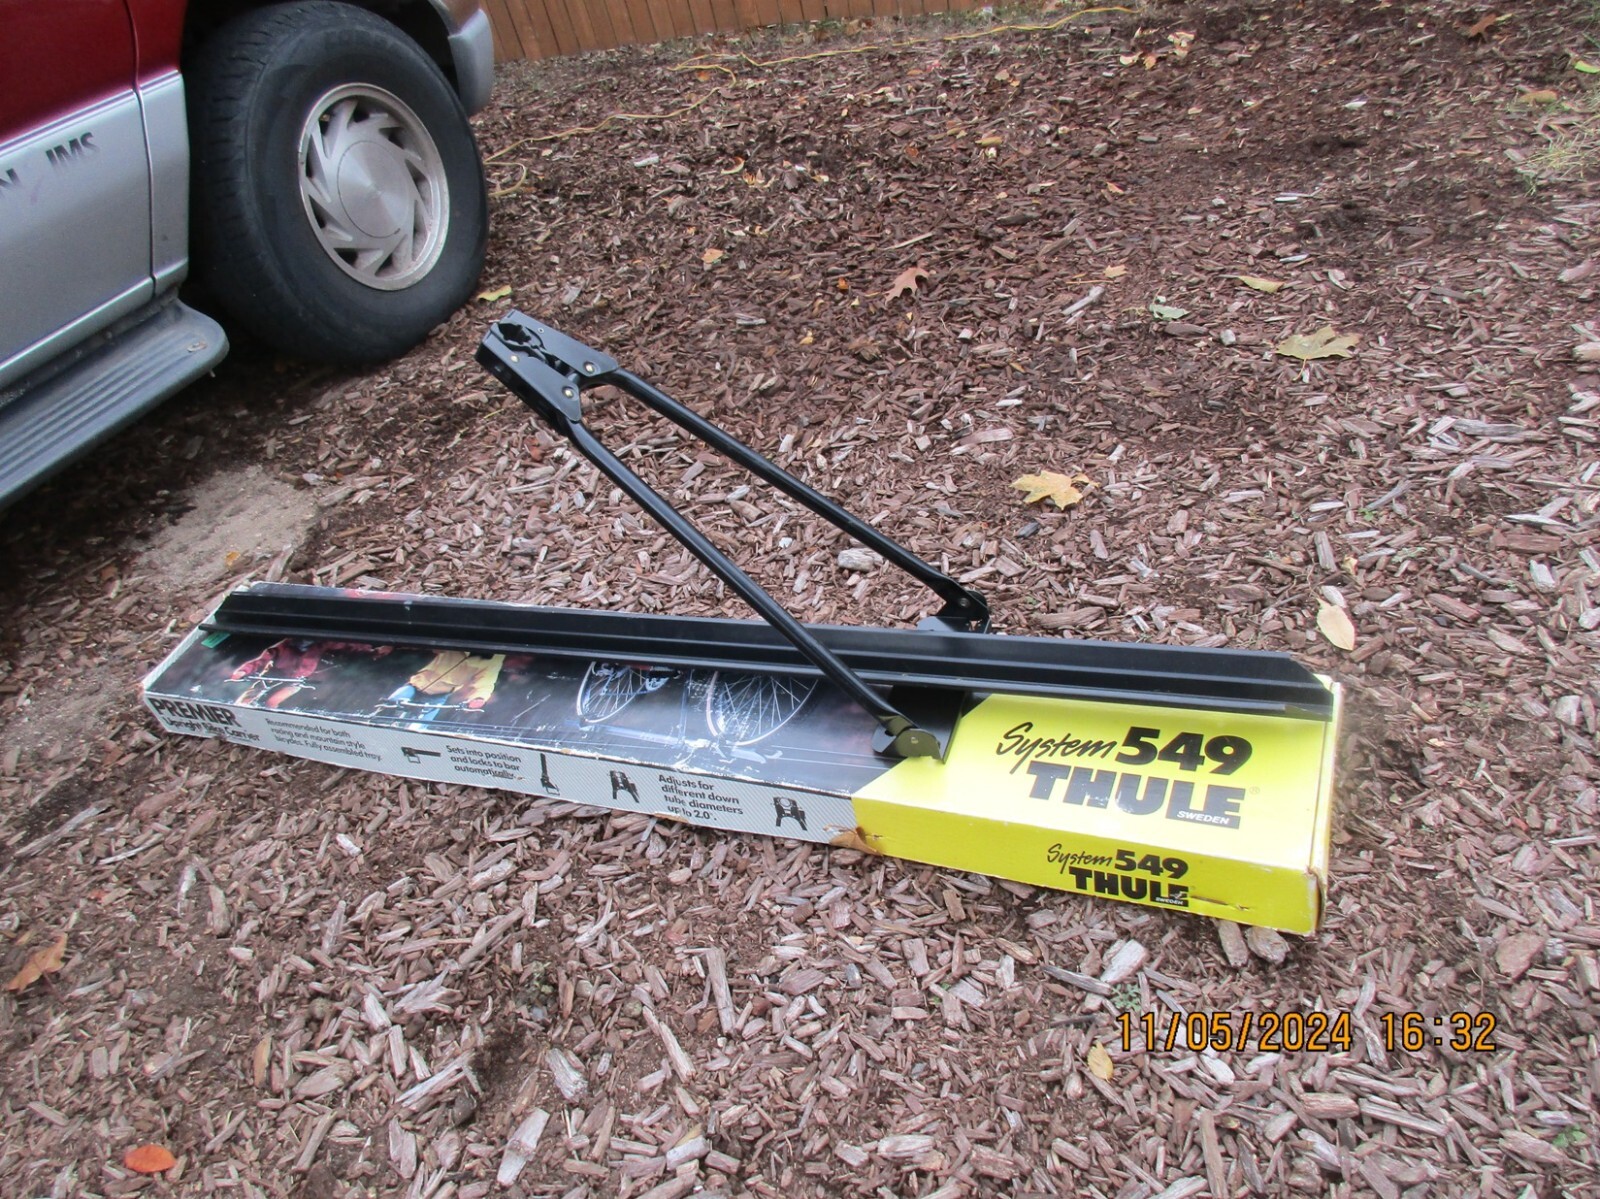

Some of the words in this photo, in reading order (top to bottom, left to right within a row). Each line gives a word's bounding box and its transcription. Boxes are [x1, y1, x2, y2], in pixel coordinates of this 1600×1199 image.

[148, 697, 242, 728] PREMIER
[224, 727, 260, 741] Carrier
[265, 718, 319, 733] Recommended
[319, 726, 331, 735] for
[331, 728, 351, 738] both
[294, 731, 309, 739] and
[310, 734, 346, 746] mountain
[346, 740, 366, 750] style
[304, 740, 322, 751] Fully
[323, 745, 364, 758] assembled
[996, 722, 1117, 775] System
[1115, 726, 1253, 776] 549
[446, 745, 465, 755] Sets
[465, 747, 484, 757] into
[485, 751, 522, 763] position
[450, 756, 468, 764] and
[469, 757, 493, 767] locks
[504, 761, 520, 771] bar
[659, 774, 697, 789] Adjusts
[697, 780, 715, 791] for
[661, 784, 706, 799] different
[708, 792, 740, 805] down
[1026, 760, 1247, 830] THULE
[664, 794, 687, 807] tube
[689, 799, 744, 815] diameters
[667, 805, 681, 814] up
[682, 808, 692, 817] to
[1177, 810, 1230, 825] SWEDEN
[1047, 843, 1113, 875] System
[1114, 849, 1189, 880] 549
[1068, 866, 1190, 908] THULE
[1155, 896, 1184, 906] SWEDEN
